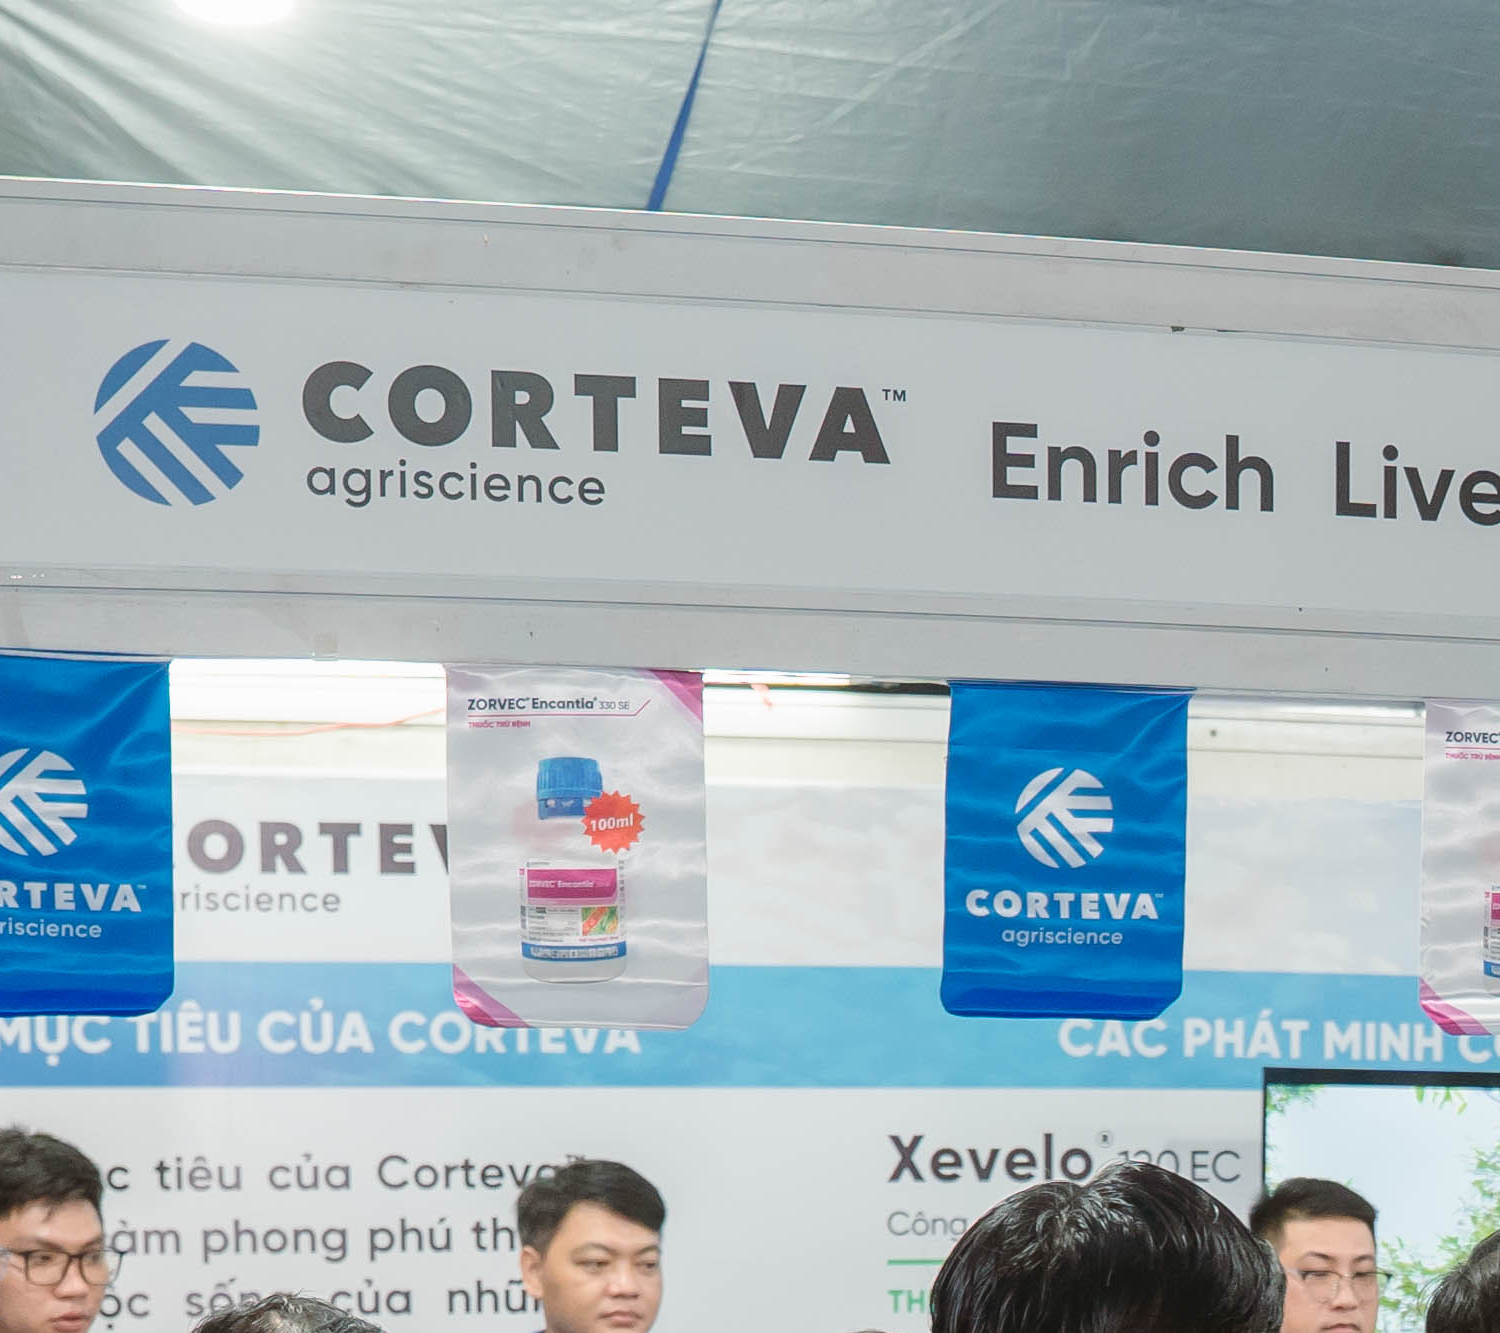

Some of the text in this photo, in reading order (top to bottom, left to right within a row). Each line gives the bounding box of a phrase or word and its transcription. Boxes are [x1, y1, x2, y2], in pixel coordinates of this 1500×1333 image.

[305, 460, 605, 510] agriscience
[990, 421, 1275, 515] Enrich
[599, 701, 616, 710] 330
[619, 701, 629, 710] SE
[590, 814, 634, 831] 100ml
[187, 819, 450, 875] ORTE
[179, 884, 341, 912] riscience
[1001, 924, 1124, 948] agriscience
[125, 1001, 240, 1054] TIÊU
[258, 997, 374, 1054] CỦA
[388, 1011, 641, 1054] CORTEVA
[1184, 1009, 1308, 1059] PHÁT
[1324, 1021, 1443, 1063] MINH
[155, 1156, 242, 1190] tiêu
[268, 1154, 350, 1190] của
[1192, 1150, 1241, 1184] EC
[203, 1217, 452, 1262] phong phú
[330, 1279, 412, 1315] của
